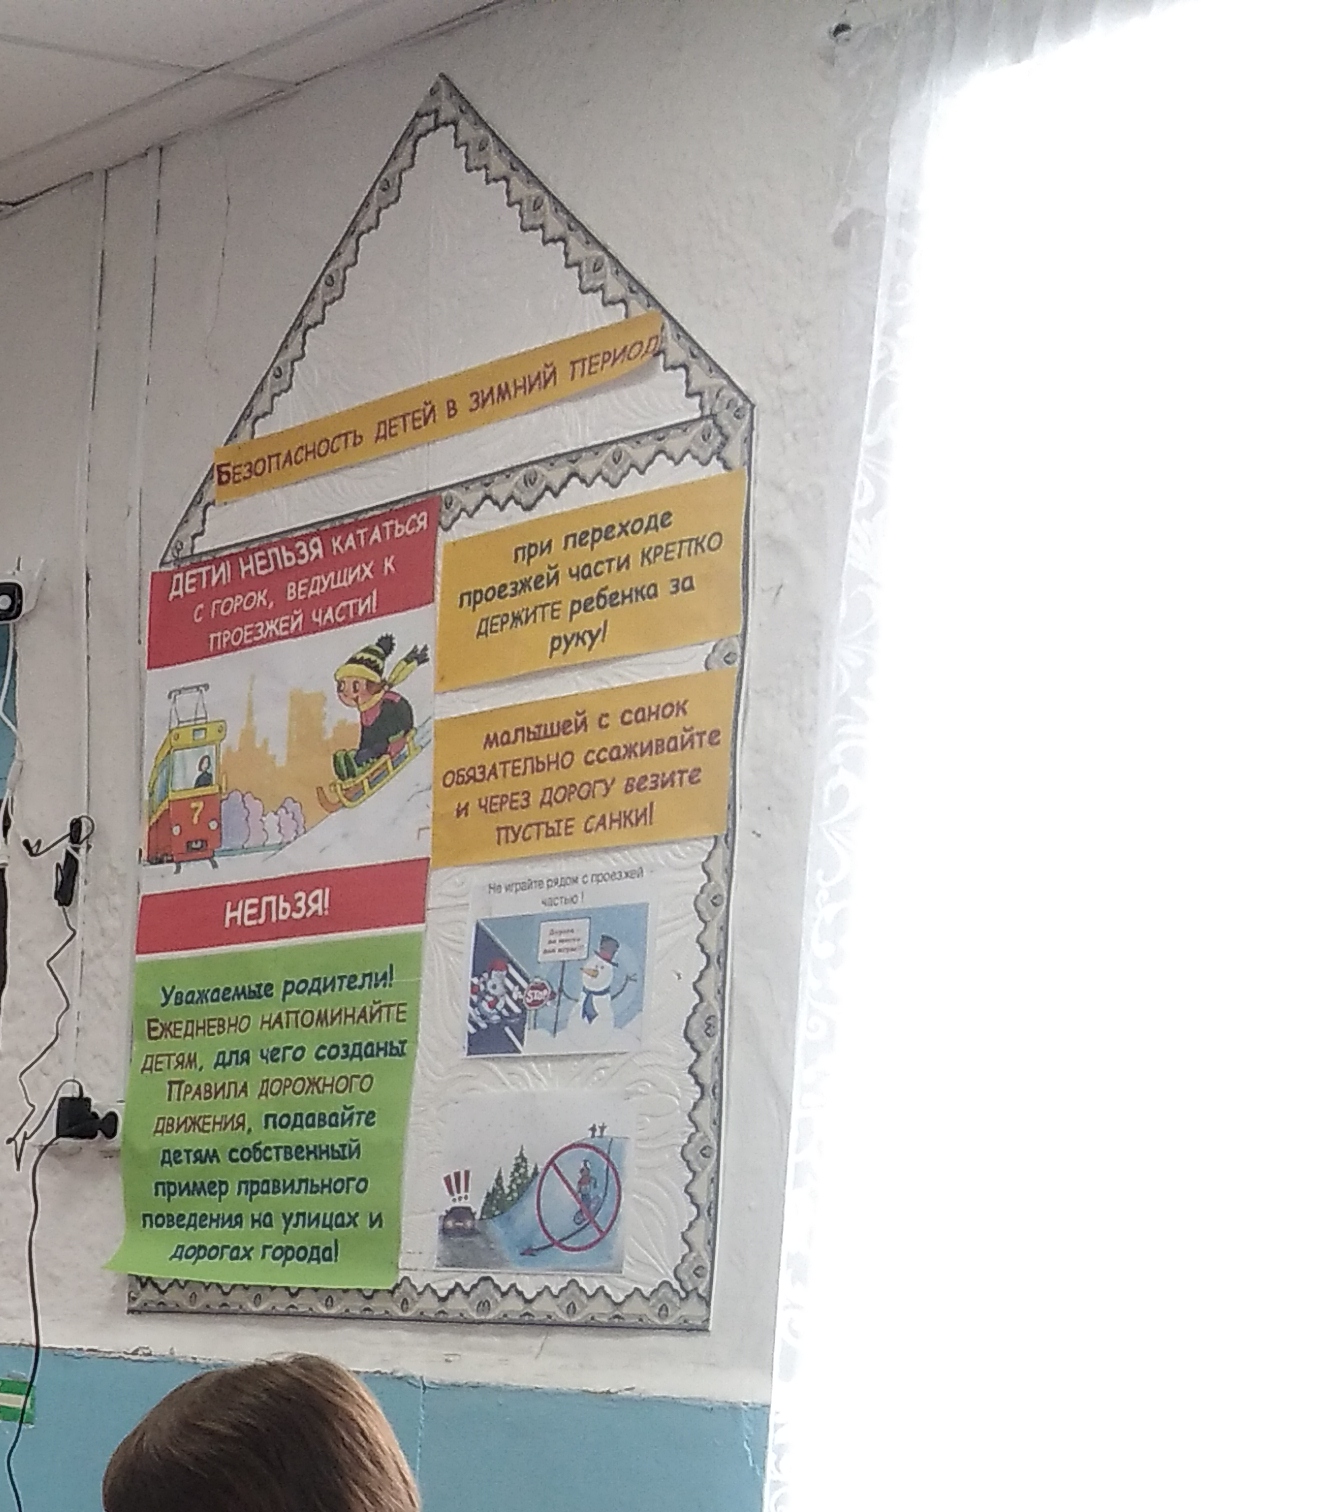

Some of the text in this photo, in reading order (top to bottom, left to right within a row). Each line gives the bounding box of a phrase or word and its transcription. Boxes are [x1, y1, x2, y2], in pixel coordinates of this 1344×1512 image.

[374, 400, 436, 441] ДЕТЕЙ
[447, 399, 458, 417] В
[469, 363, 557, 414] ЗИМНИЙ
[570, 334, 660, 381] ПЕРИОД
[168, 511, 429, 602] ДЕТИ! НЕЛЬЗЯ КАТАТЬСЯ
[513, 510, 673, 564] при переходе
[211, 589, 274, 619] ГОРОК,
[286, 562, 374, 601] ВЕДУЩИХ
[383, 555, 396, 576] К
[458, 532, 723, 611] проезжей части КРЕПКО
[208, 589, 378, 652] ПРОЕЗЖЕЙ ЧАСТИ!
[476, 574, 695, 639] ДЕРЖИТЕ ребенка за
[548, 619, 609, 660] руку!
[483, 699, 690, 750] малышей с санок
[442, 727, 721, 788] ОБЯЗАТЕЛЬНО ссаживайте
[190, 800, 205, 825] 7
[455, 766, 701, 818] и ЧЕРЕЗ ДОРОГУ везите
[496, 801, 655, 846] ПУСТЫЕ САНКИ!
[488, 883, 502, 894] Не
[504, 878, 544, 894] играйте
[546, 875, 578, 892] рядом
[591, 866, 644, 885] проезжей
[224, 887, 330, 929] НЕЛЬЗЯ!
[160, 964, 394, 1008] Уважаемые родители!
[259, 1000, 408, 1031] НАПОМИНАЙТЕ
[141, 1038, 408, 1073] ДЕТЯМ, для чего созданы
[258, 1073, 374, 1100] ДОРОЖНОГО
[153, 1104, 377, 1136] ДВИЖЕНИЯ, подавайте
[160, 1138, 361, 1167] детям собственный
[154, 1176, 369, 1202] пример правильного
[141, 1210, 384, 1234] поведения на улицах и
[168, 1238, 339, 1267] дорогах города!
